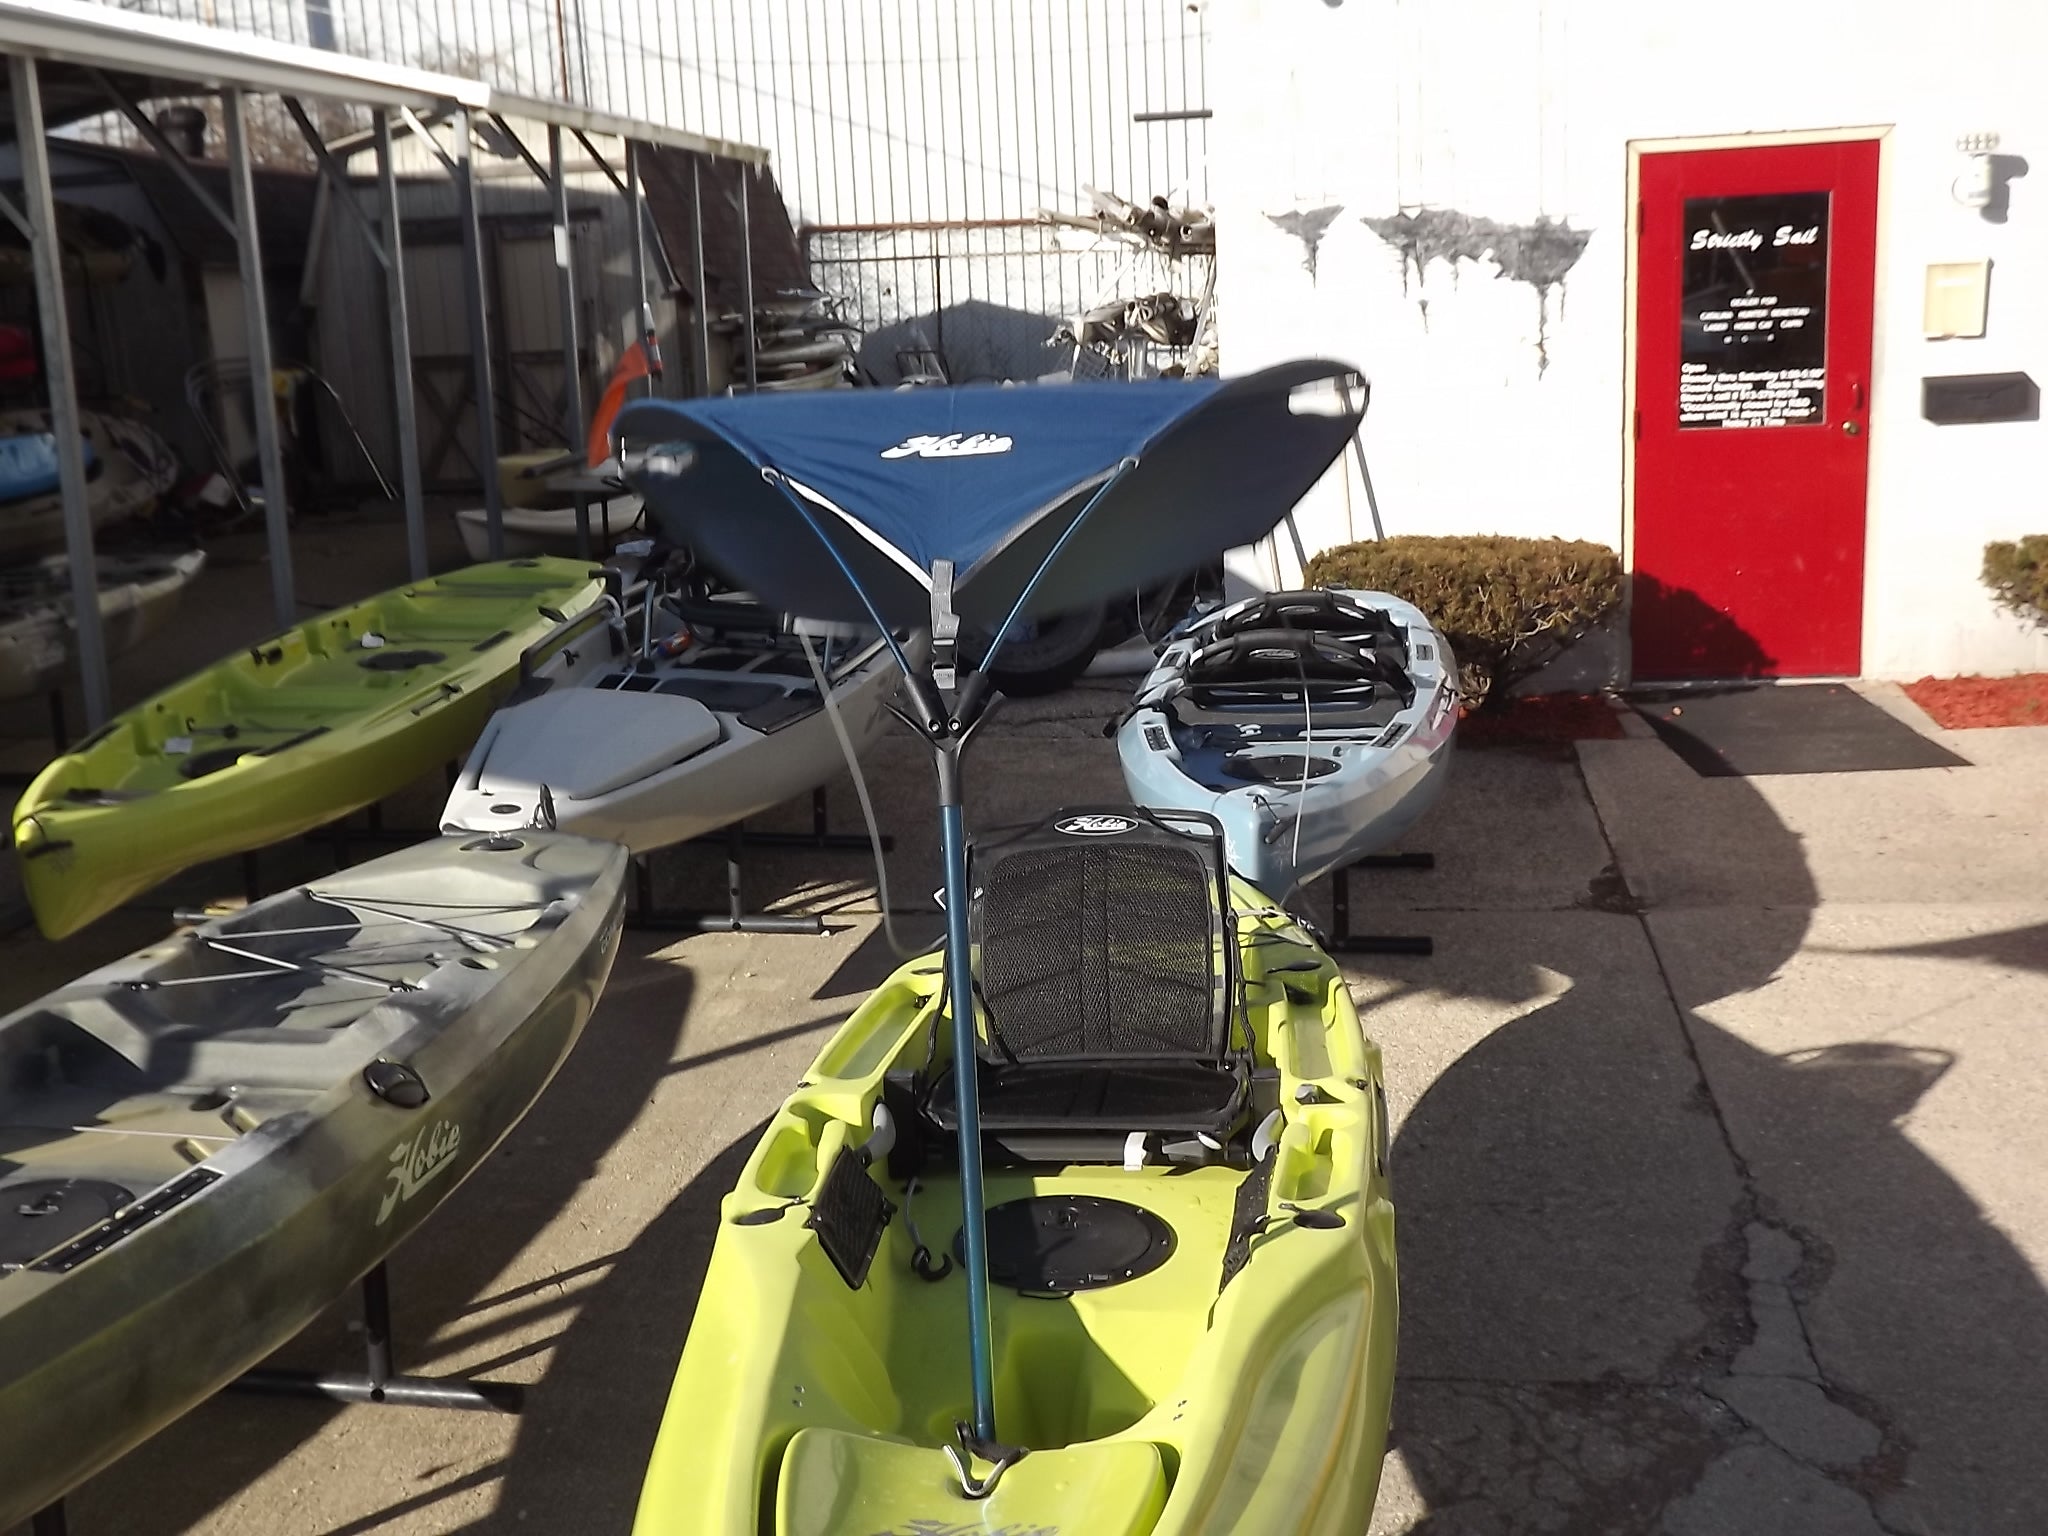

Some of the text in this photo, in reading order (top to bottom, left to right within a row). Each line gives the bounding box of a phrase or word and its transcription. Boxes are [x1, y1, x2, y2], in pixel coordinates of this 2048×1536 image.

[1690, 225, 1818, 251] Strictly Sail
[1681, 363, 1707, 374] Open
[1680, 374, 1717, 384] Monday
[1738, 371, 1780, 384] Saturday
[1680, 383, 1712, 393] Closed
[1742, 399, 1773, 410] closed
[880, 432, 1013, 459] Hobie
[1065, 817, 1127, 831] Hobie
[375, 1120, 460, 1227] Hobie
